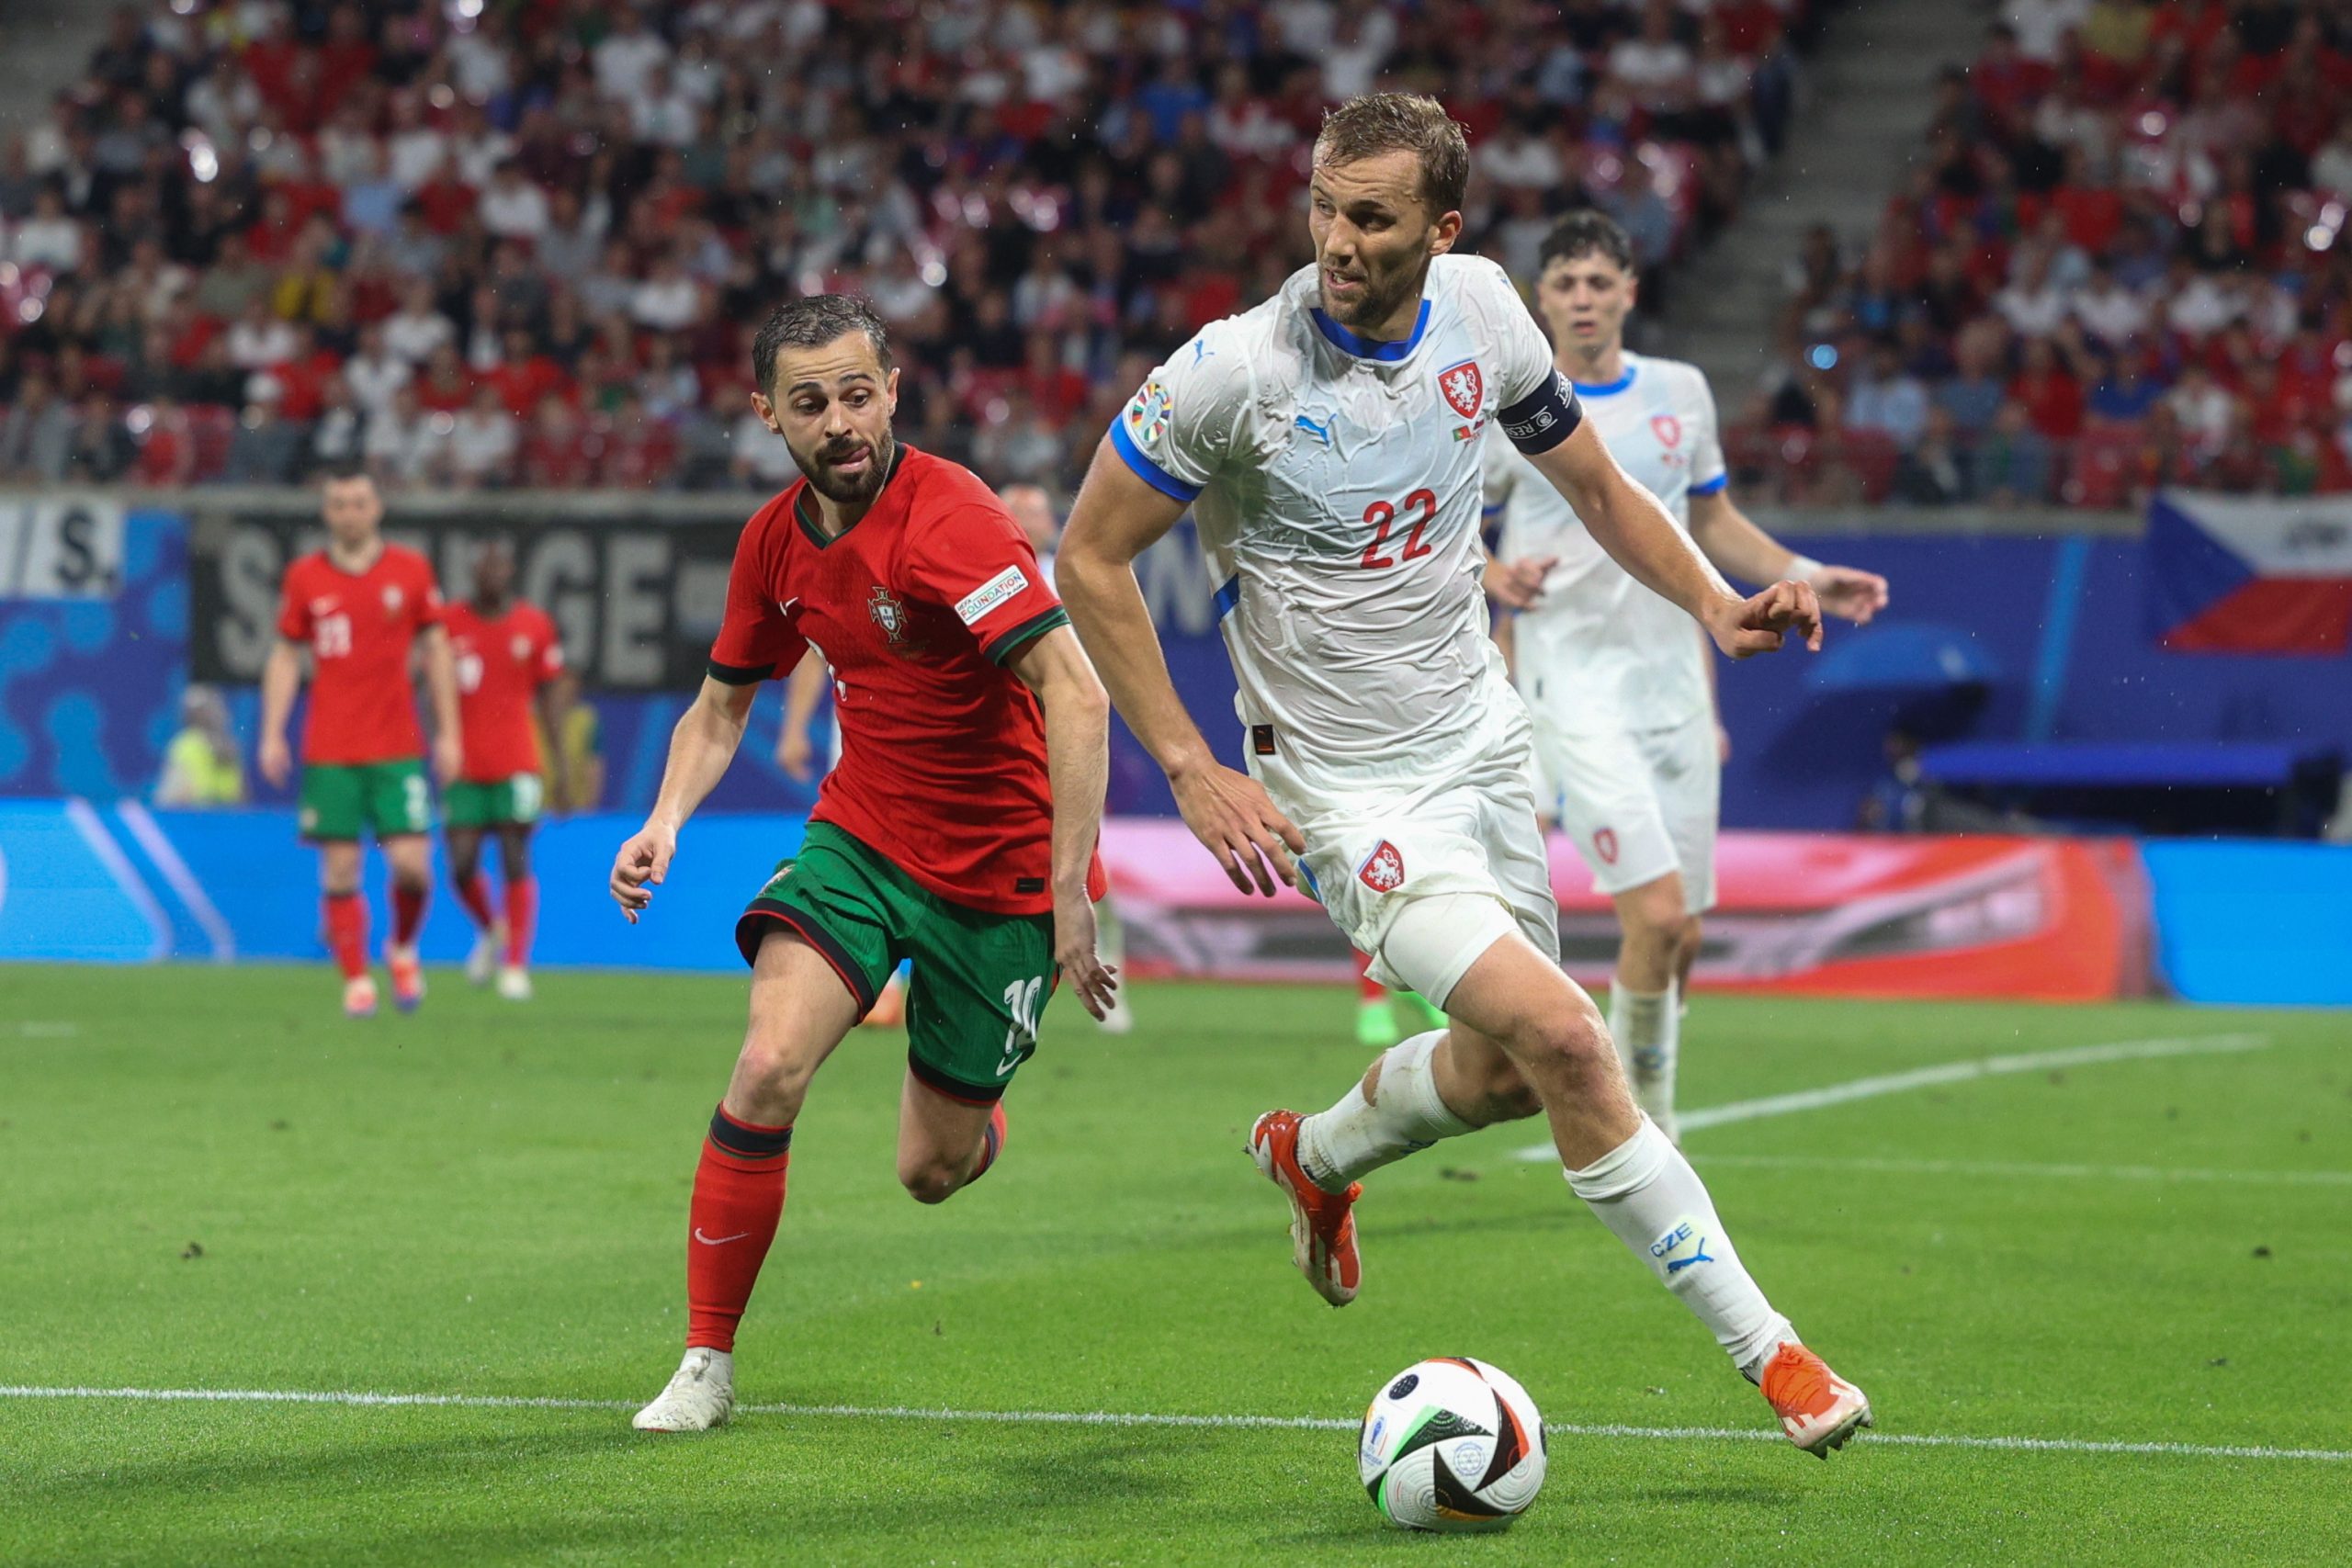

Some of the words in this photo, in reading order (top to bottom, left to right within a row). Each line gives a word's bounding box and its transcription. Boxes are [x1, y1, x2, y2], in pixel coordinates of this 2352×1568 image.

[1361, 489, 1436, 569] 22
[960, 574, 1022, 618] FOUNDATION
[1651, 1223, 1693, 1258] CZE
